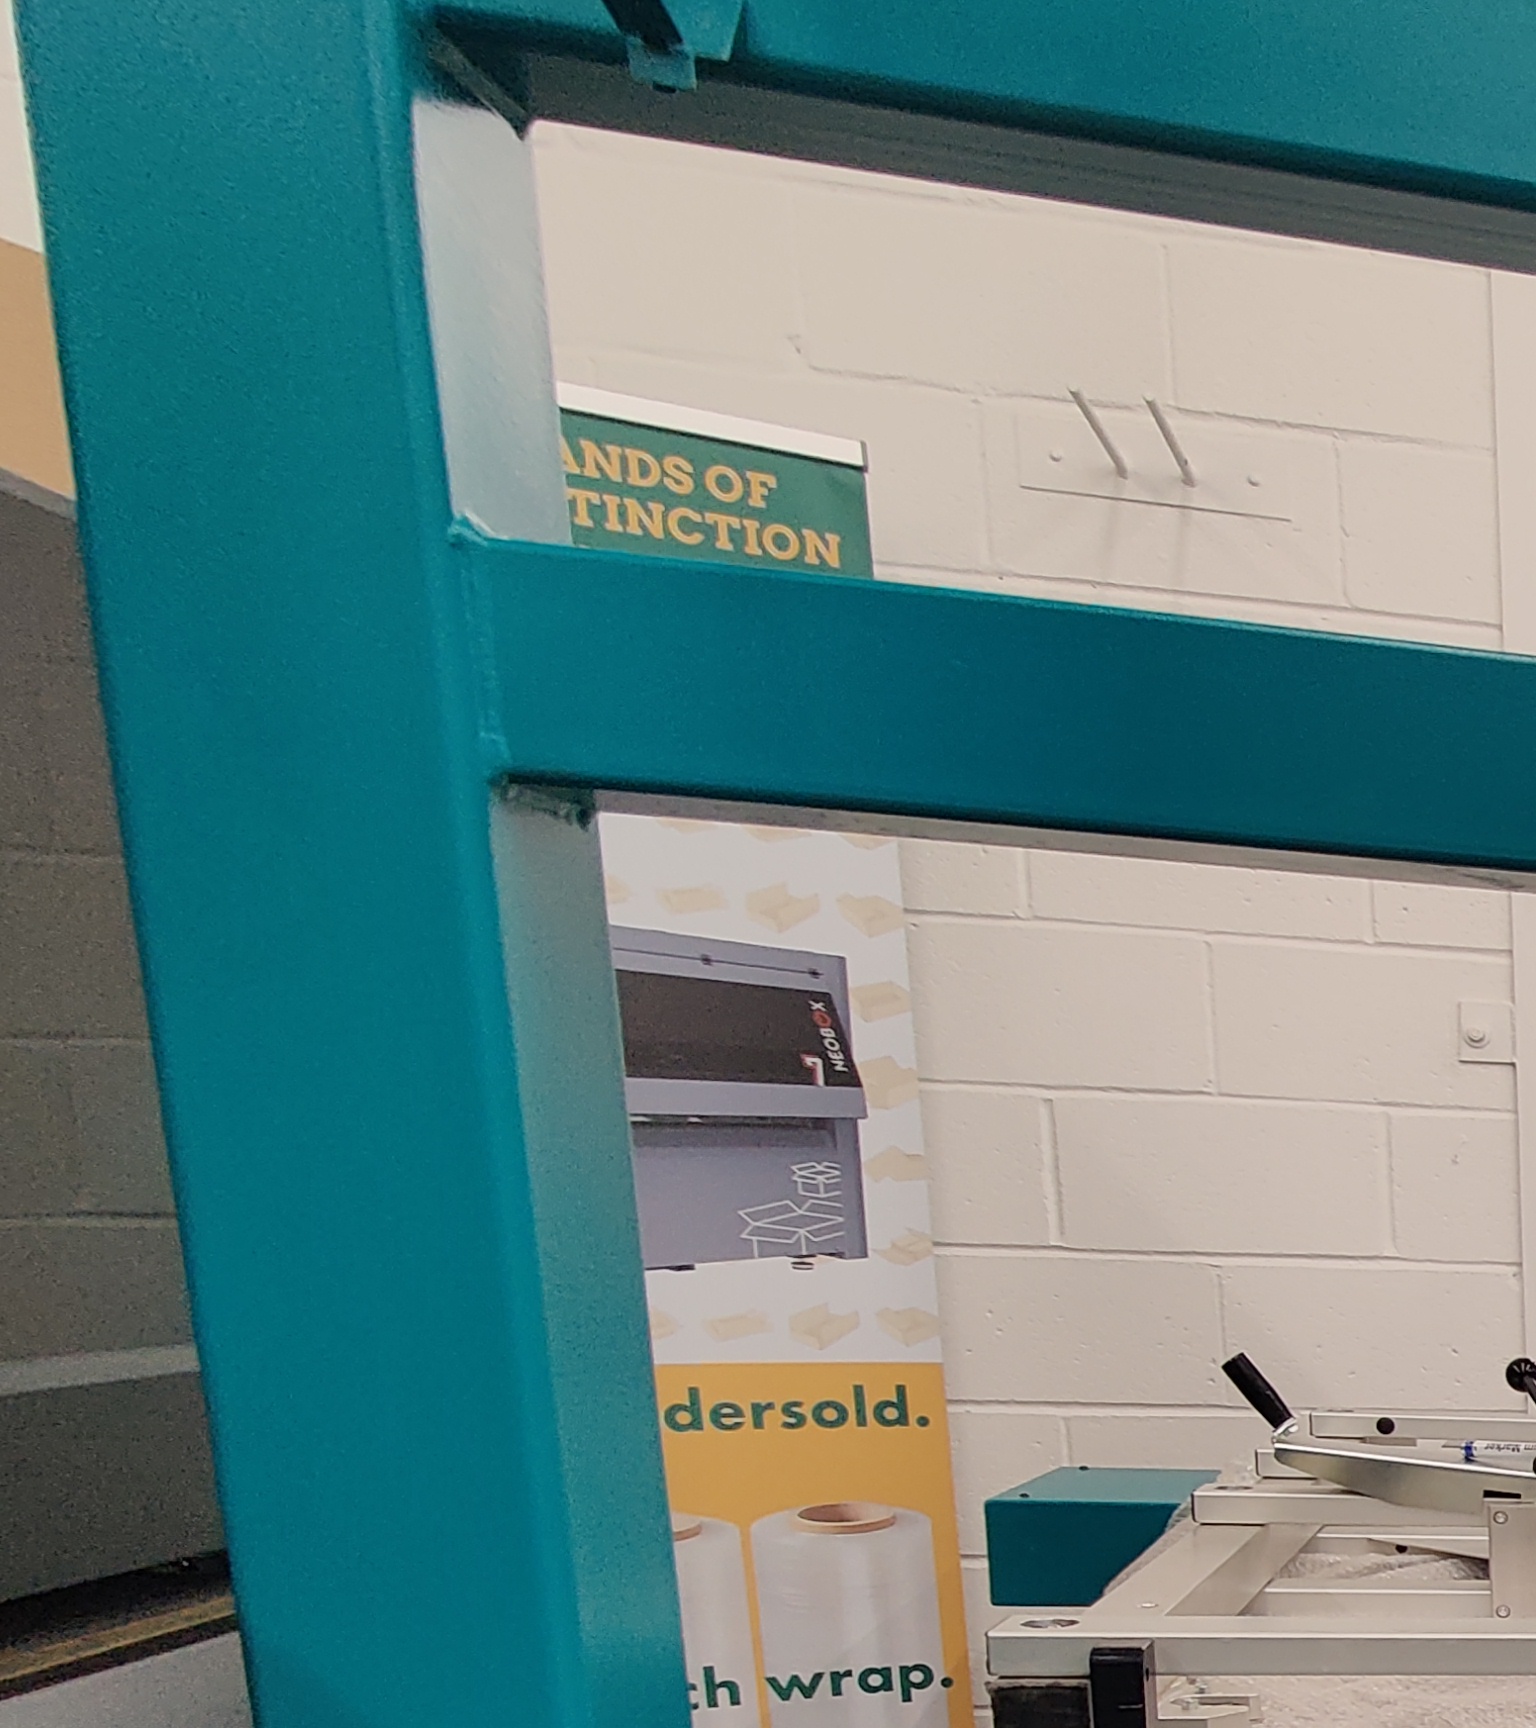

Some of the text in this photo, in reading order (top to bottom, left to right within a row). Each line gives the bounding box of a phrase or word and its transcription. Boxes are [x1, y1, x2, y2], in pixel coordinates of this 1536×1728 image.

[704, 465, 777, 508] OF
[566, 487, 842, 568] TINCTION
[663, 1384, 931, 1432] dersold.
[764, 1663, 954, 1703] wrap.
